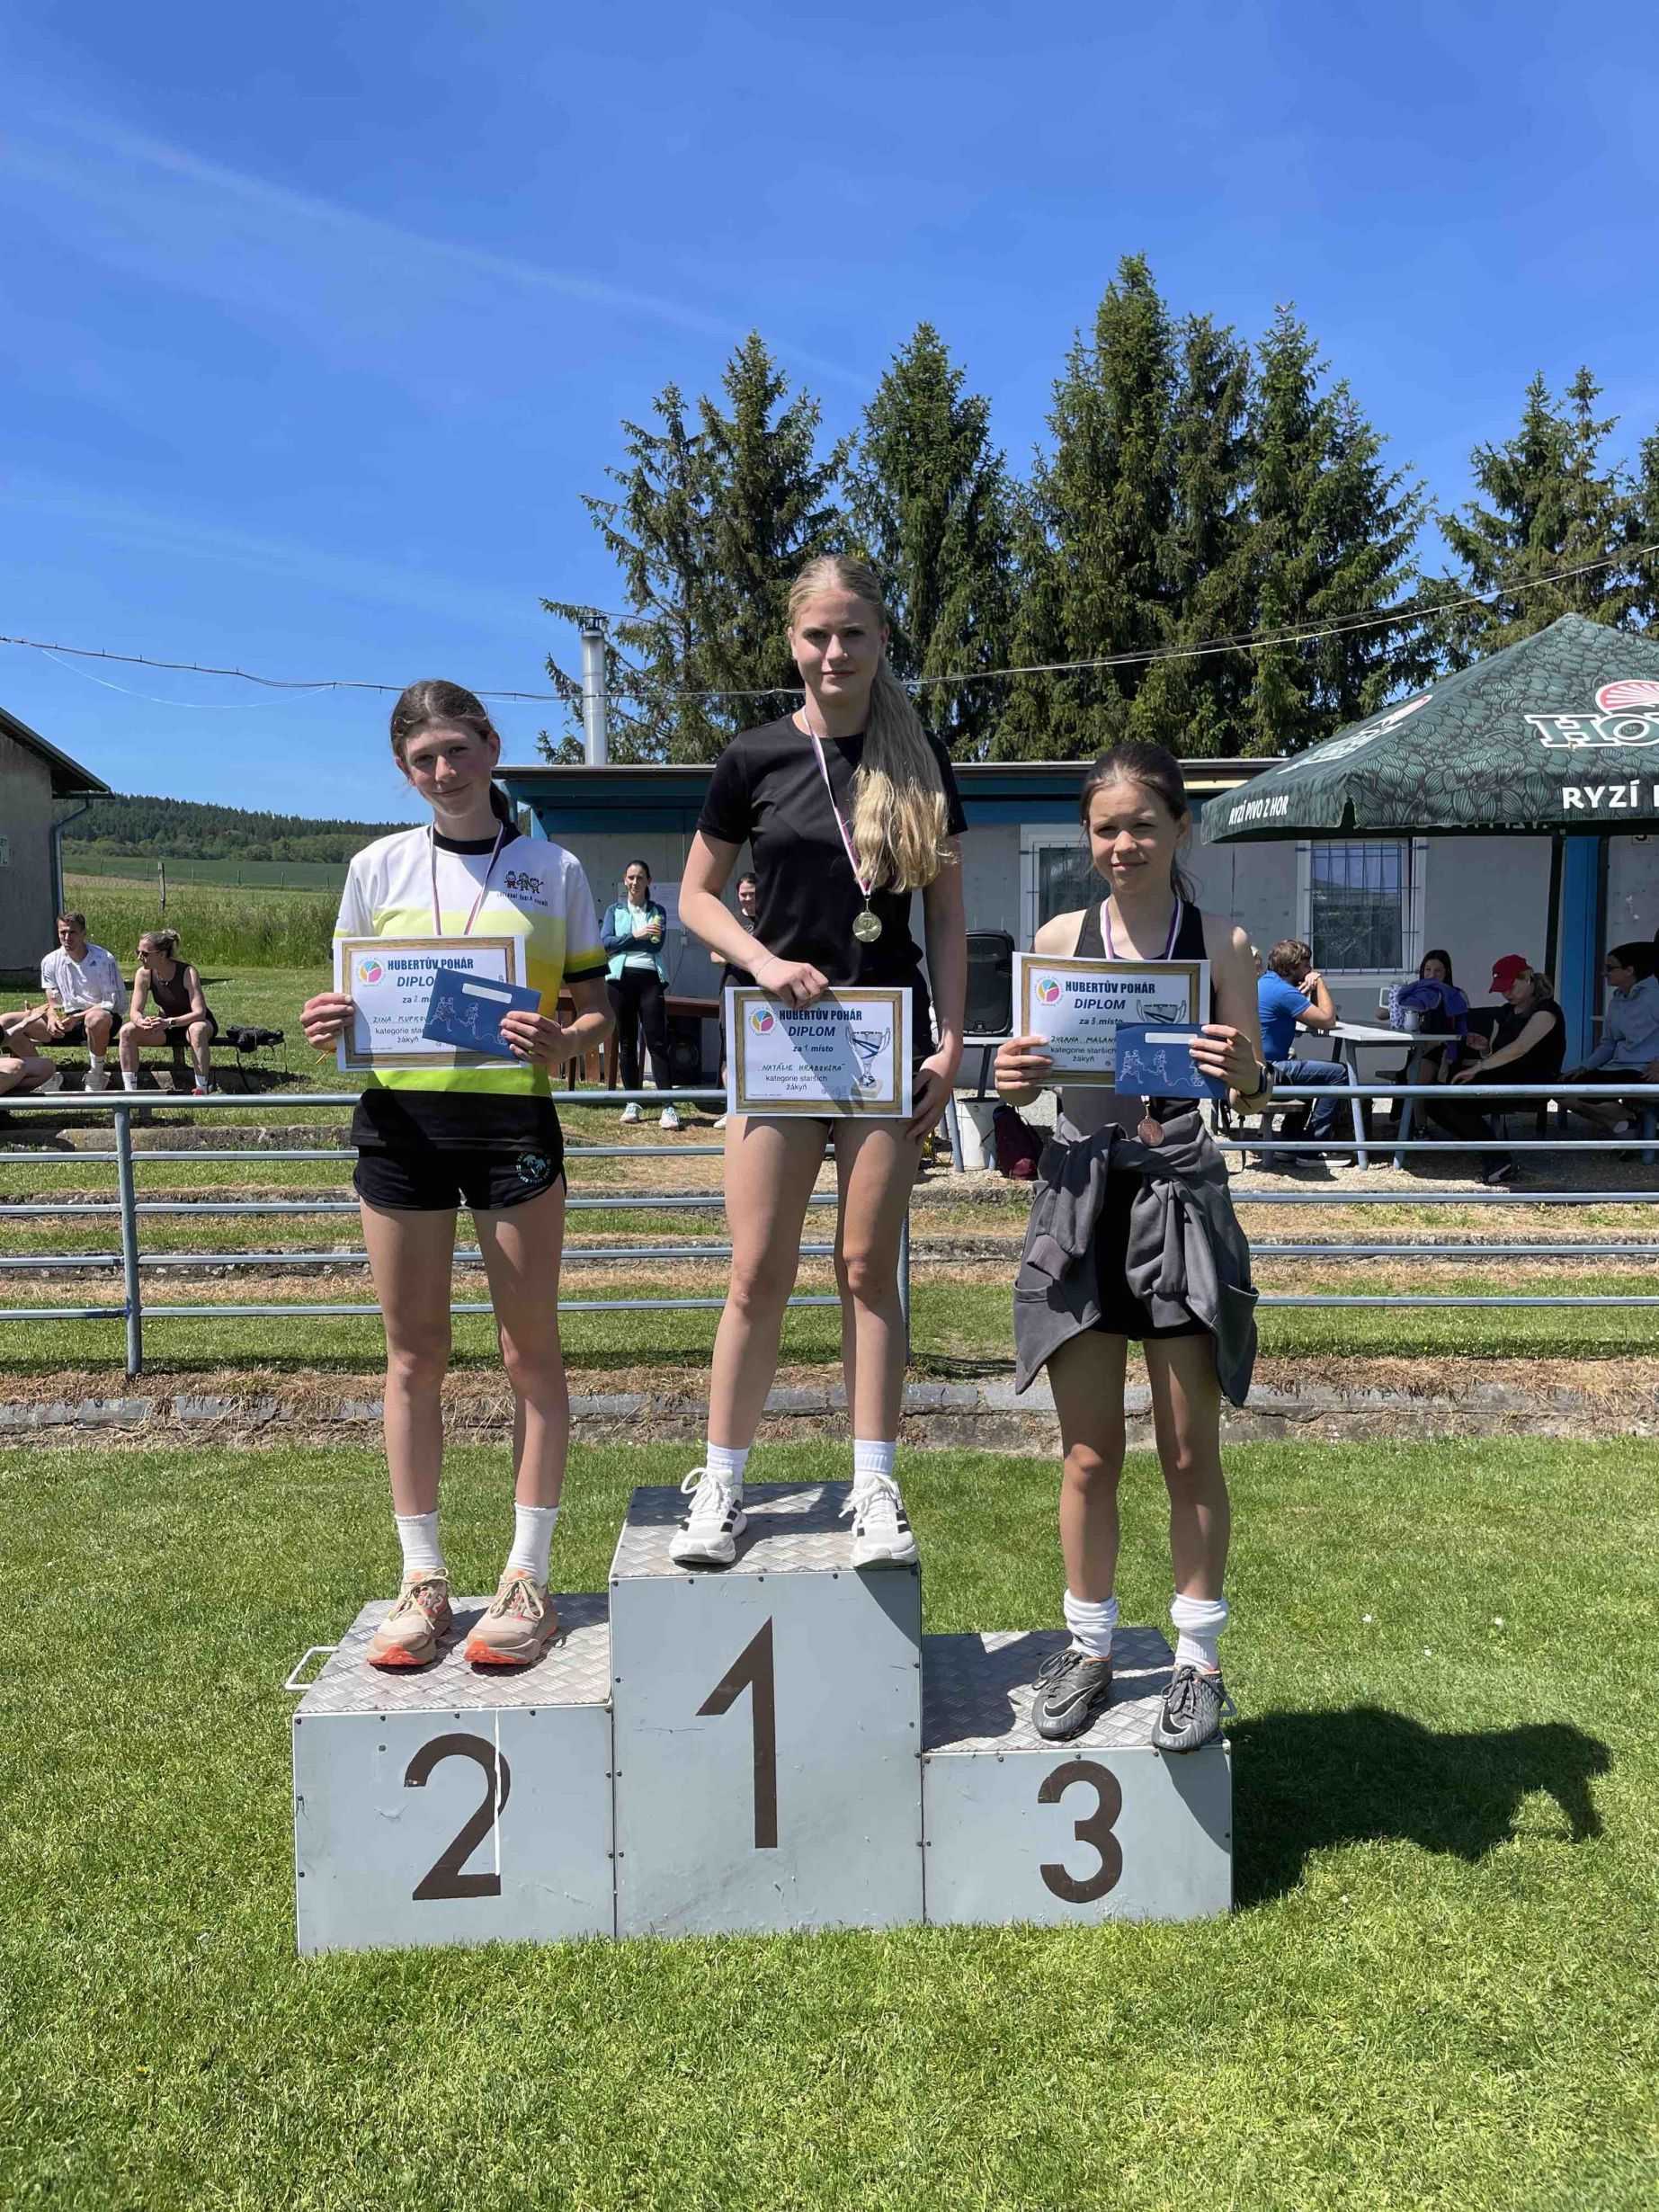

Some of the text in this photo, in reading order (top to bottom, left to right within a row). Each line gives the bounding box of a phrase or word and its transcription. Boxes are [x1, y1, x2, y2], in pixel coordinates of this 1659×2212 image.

[1524, 713, 1659, 747] HO
[1562, 779, 1640, 809] RYZÍ
[1228, 795, 1289, 825] RYZÍ PIVO Z HOR
[388, 957, 439, 971] HUBERTŮV
[442, 957, 474, 969] POHÁR
[397, 976, 435, 987] DIPLO
[1066, 979, 1119, 993] HUBERTŮV
[1120, 981, 1155, 994] POHÁR
[1074, 998, 1126, 1010] DIPLOM
[779, 1007, 829, 1021] HUBERTŮV
[830, 1008, 862, 1021] POHÁR
[788, 1026, 835, 1037] DIPLOM
[811, 1044, 834, 1052] místo
[1050, 1047, 1085, 1055] kategorie
[1072, 1056, 1094, 1064] žákyň
[765, 1075, 798, 1083] kategorie
[786, 1084, 807, 1092] žákyň
[696, 1616, 778, 1850] 1
[404, 1733, 511, 1901] 2
[1038, 1761, 1123, 1903] 3
